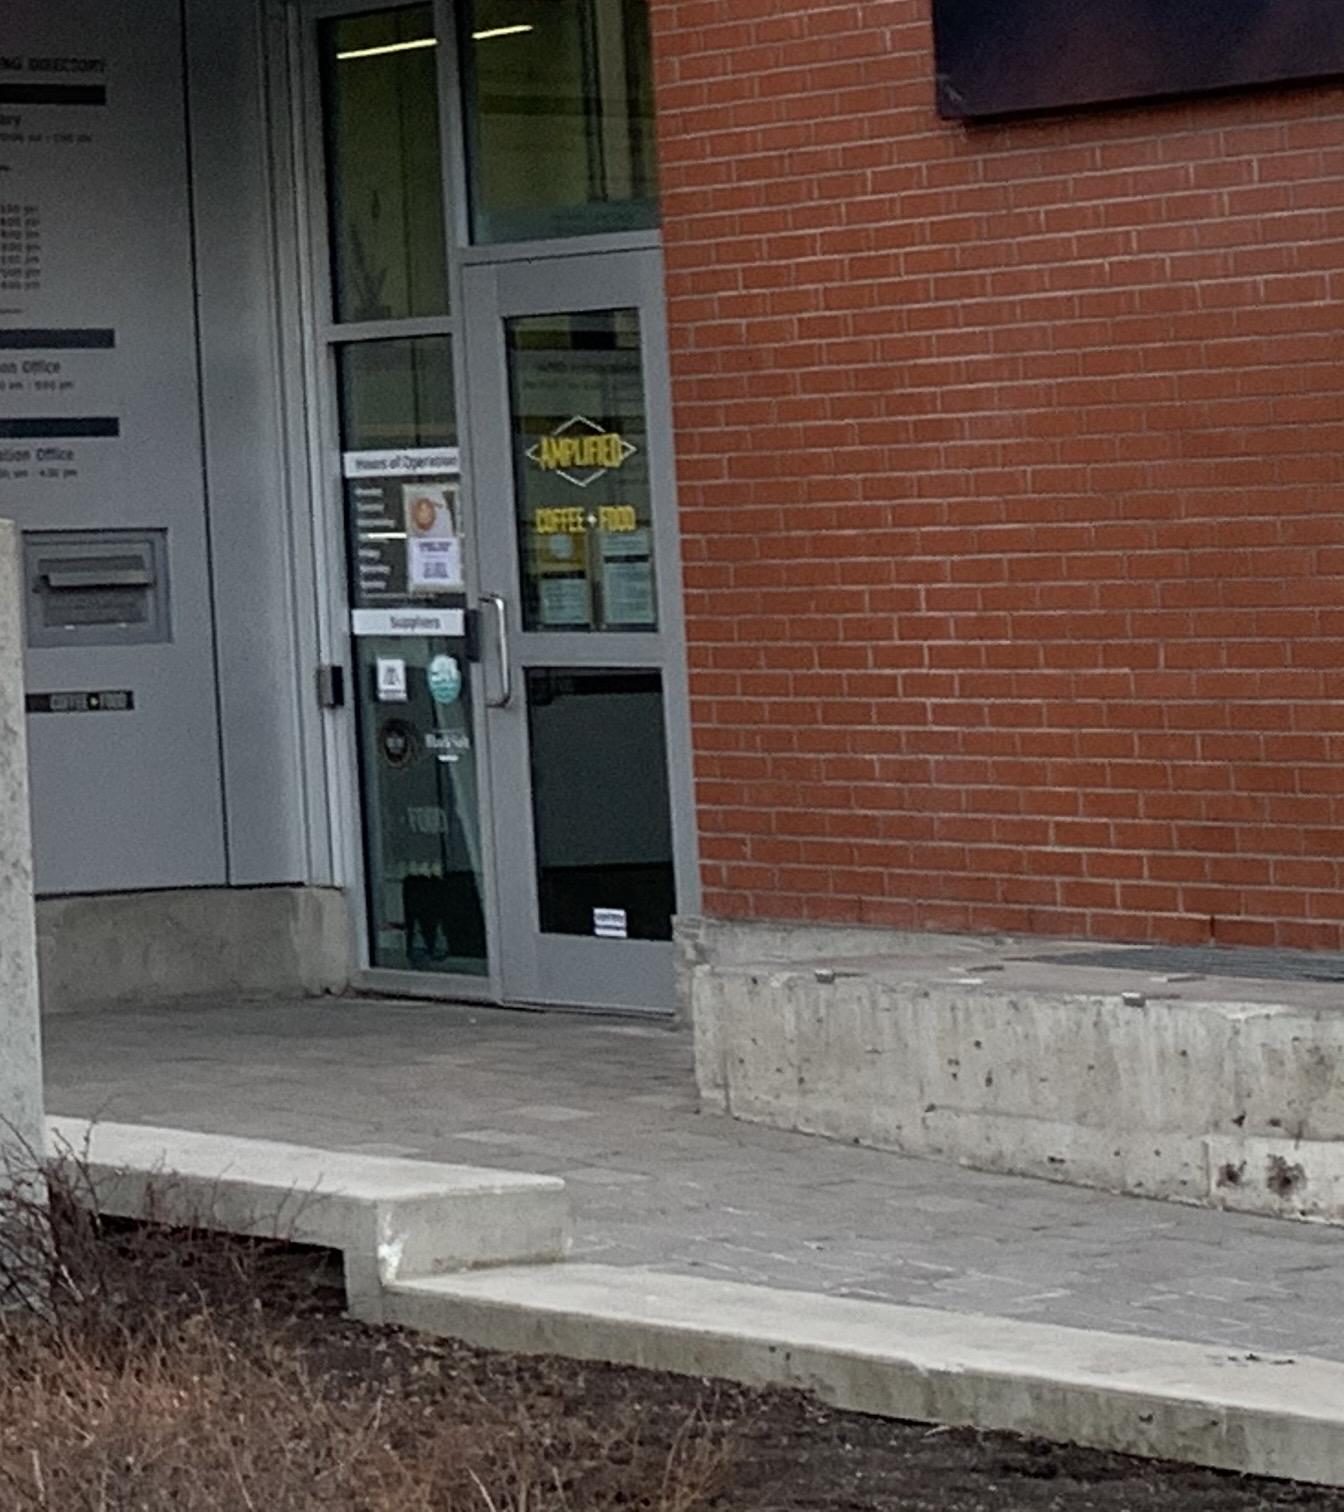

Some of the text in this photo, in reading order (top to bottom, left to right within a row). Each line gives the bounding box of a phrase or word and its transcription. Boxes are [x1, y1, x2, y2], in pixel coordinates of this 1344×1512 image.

[539, 433, 623, 471] AMPLIFIED
[535, 505, 637, 534] COFFEE FOOD
